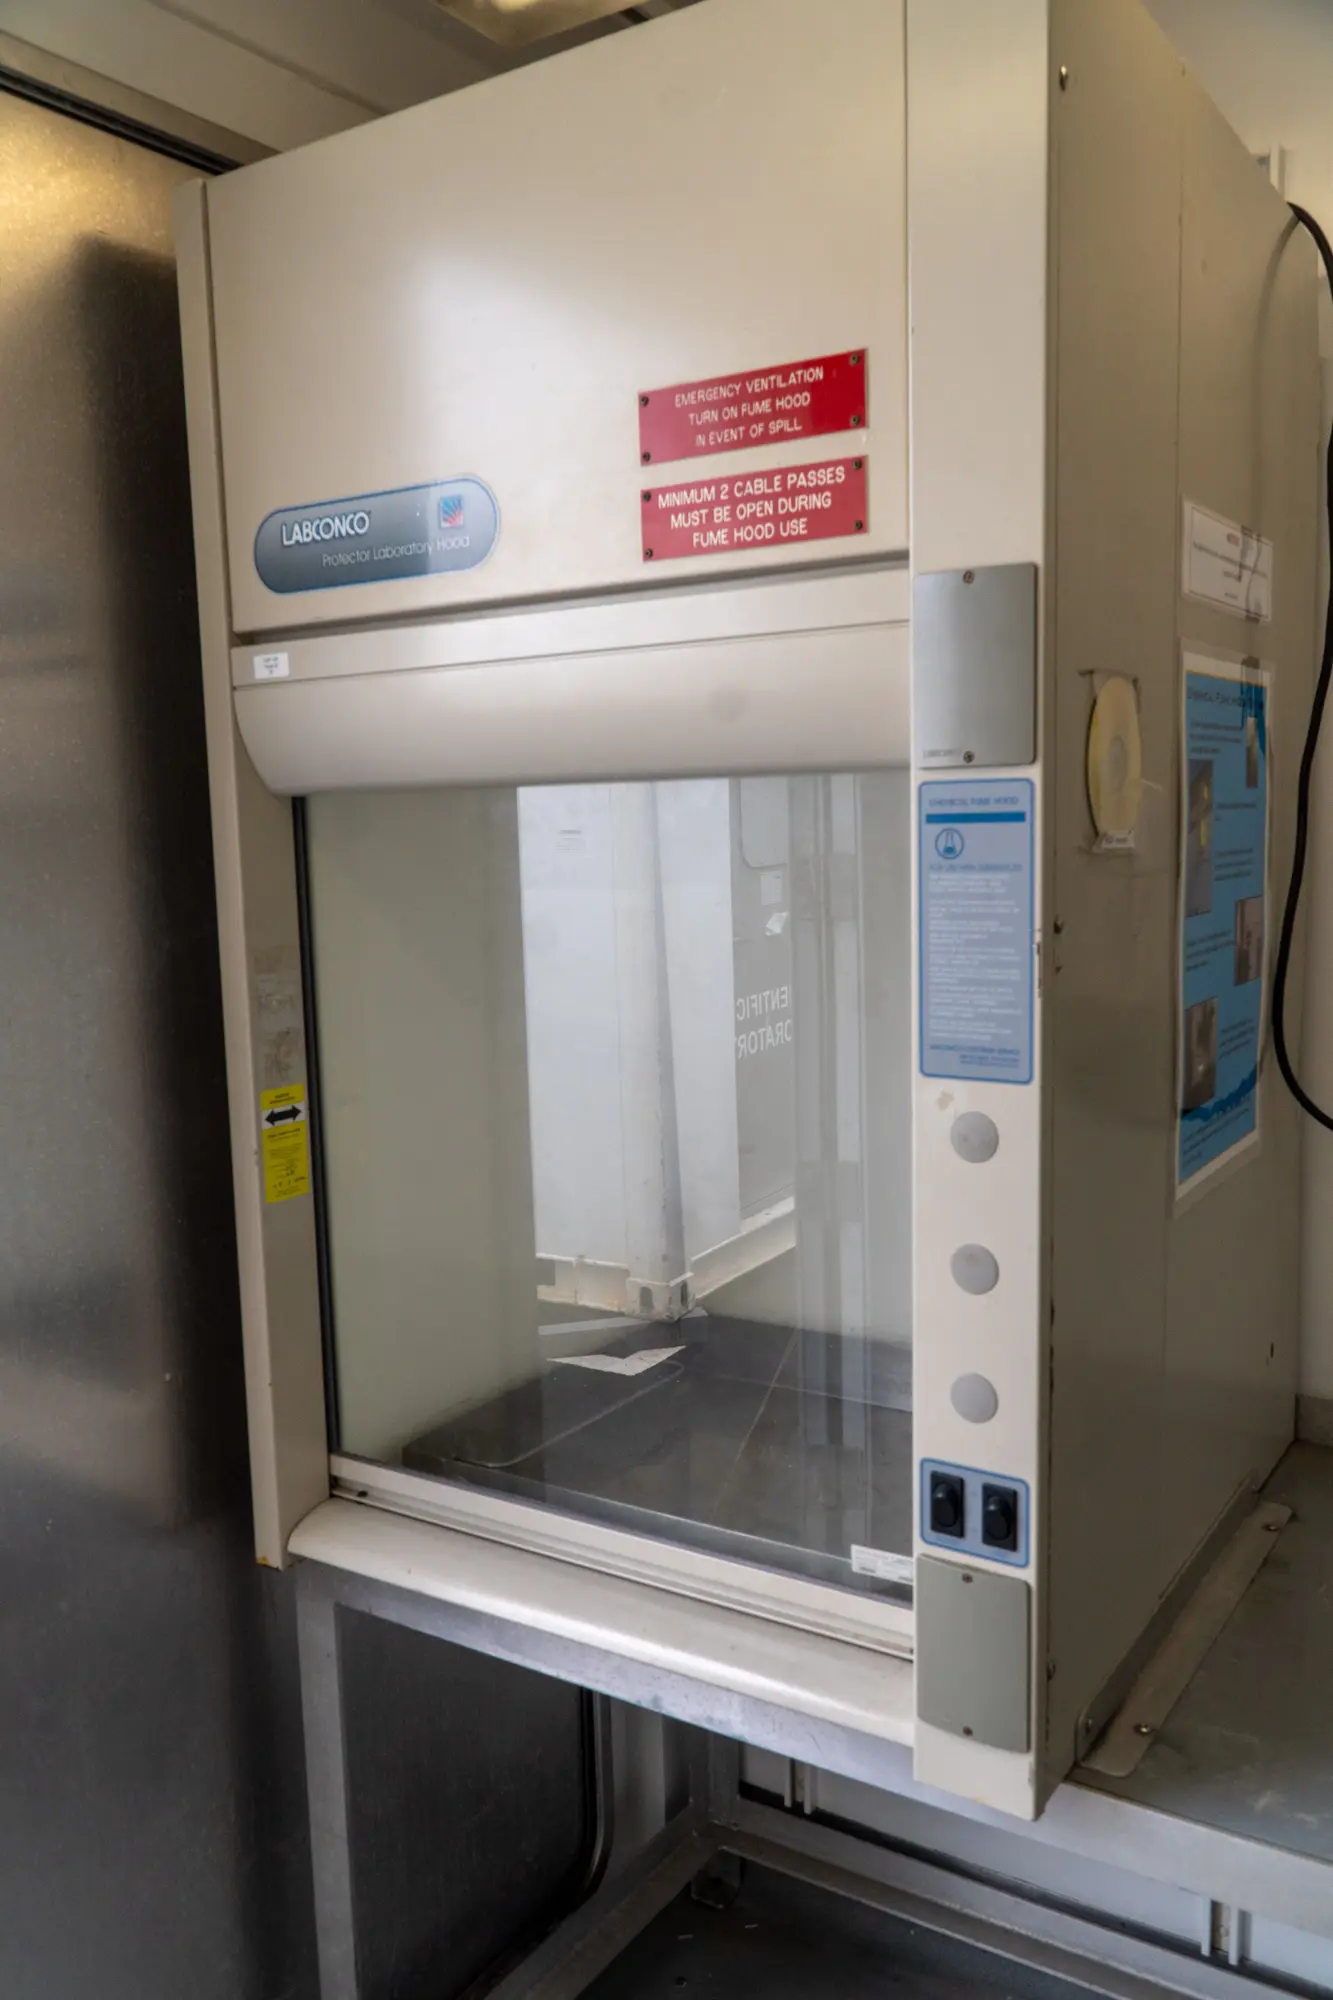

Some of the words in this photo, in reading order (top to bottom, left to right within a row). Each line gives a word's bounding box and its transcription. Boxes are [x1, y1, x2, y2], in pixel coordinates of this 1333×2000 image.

[675, 383, 741, 408] EMERGENCY
[746, 366, 824, 393] VENTILATION
[688, 409, 719, 426] TURN
[722, 406, 738, 421] ON
[741, 400, 772, 417] FUME
[776, 392, 810, 410] HOOD
[695, 433, 706, 447] IN
[709, 426, 745, 445] EVENT
[749, 423, 765, 438] OF
[768, 417, 802, 434] SPILL
[658, 486, 716, 509] MINIMUM
[720, 483, 728, 500] 2
[734, 475, 782, 497] CABLE
[787, 465, 845, 489] PASSES
[670, 509, 709, 529] MUST
[713, 505, 731, 523] BE
[736, 500, 774, 520] OPEN
[778, 491, 832, 515] DURING
[281, 511, 370, 546] LABCONCO
[693, 528, 729, 548] FUME
[733, 523, 775, 543] HOOD
[779, 518, 808, 537] USE
[322, 548, 371, 568] Protector
[373, 540, 434, 561] Laboratory
[437, 535, 470, 551] Hood
